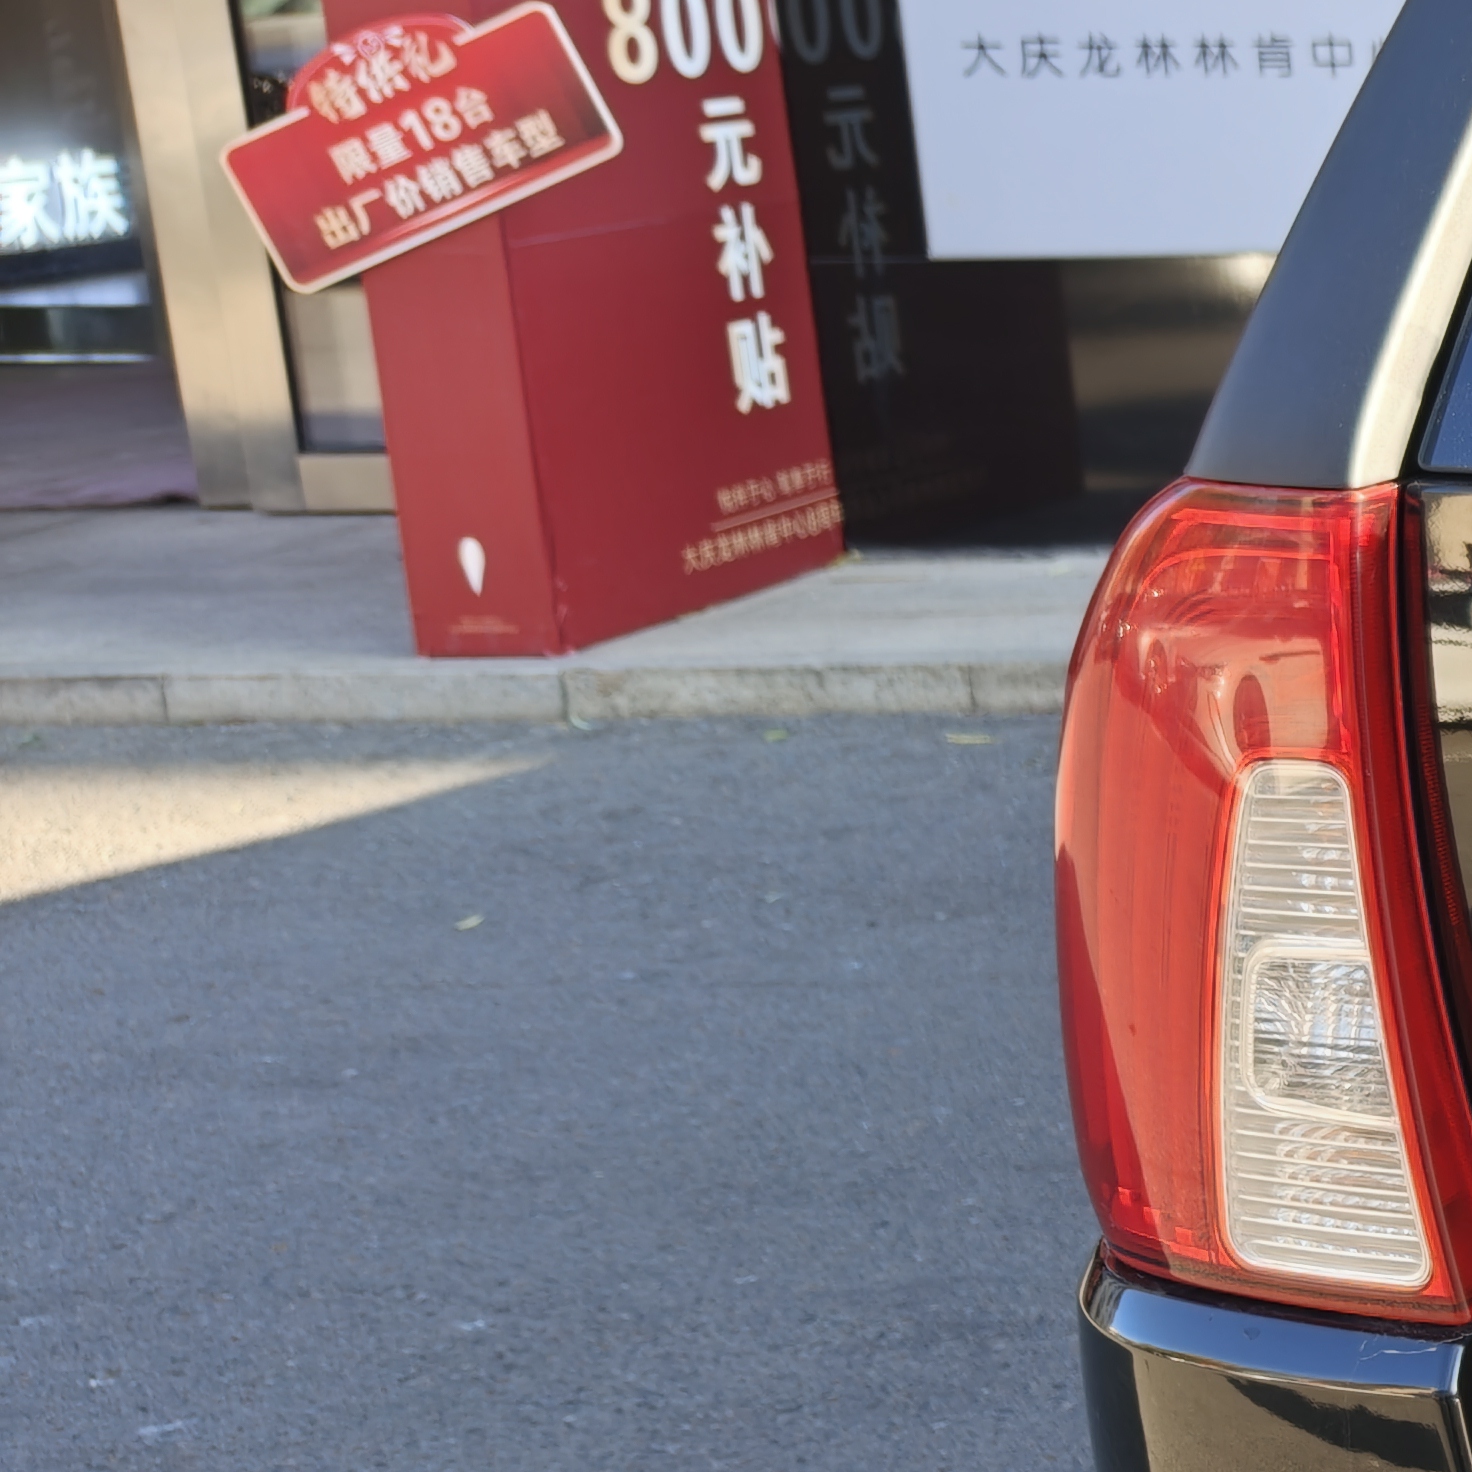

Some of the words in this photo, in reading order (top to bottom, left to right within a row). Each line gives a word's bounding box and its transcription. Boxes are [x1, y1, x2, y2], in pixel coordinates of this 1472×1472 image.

[960, 30, 1383, 80] 大庆龙林林肯中
[314, 108, 566, 250] 出厂价销售车型
[328, 85, 496, 186] 限量18台
